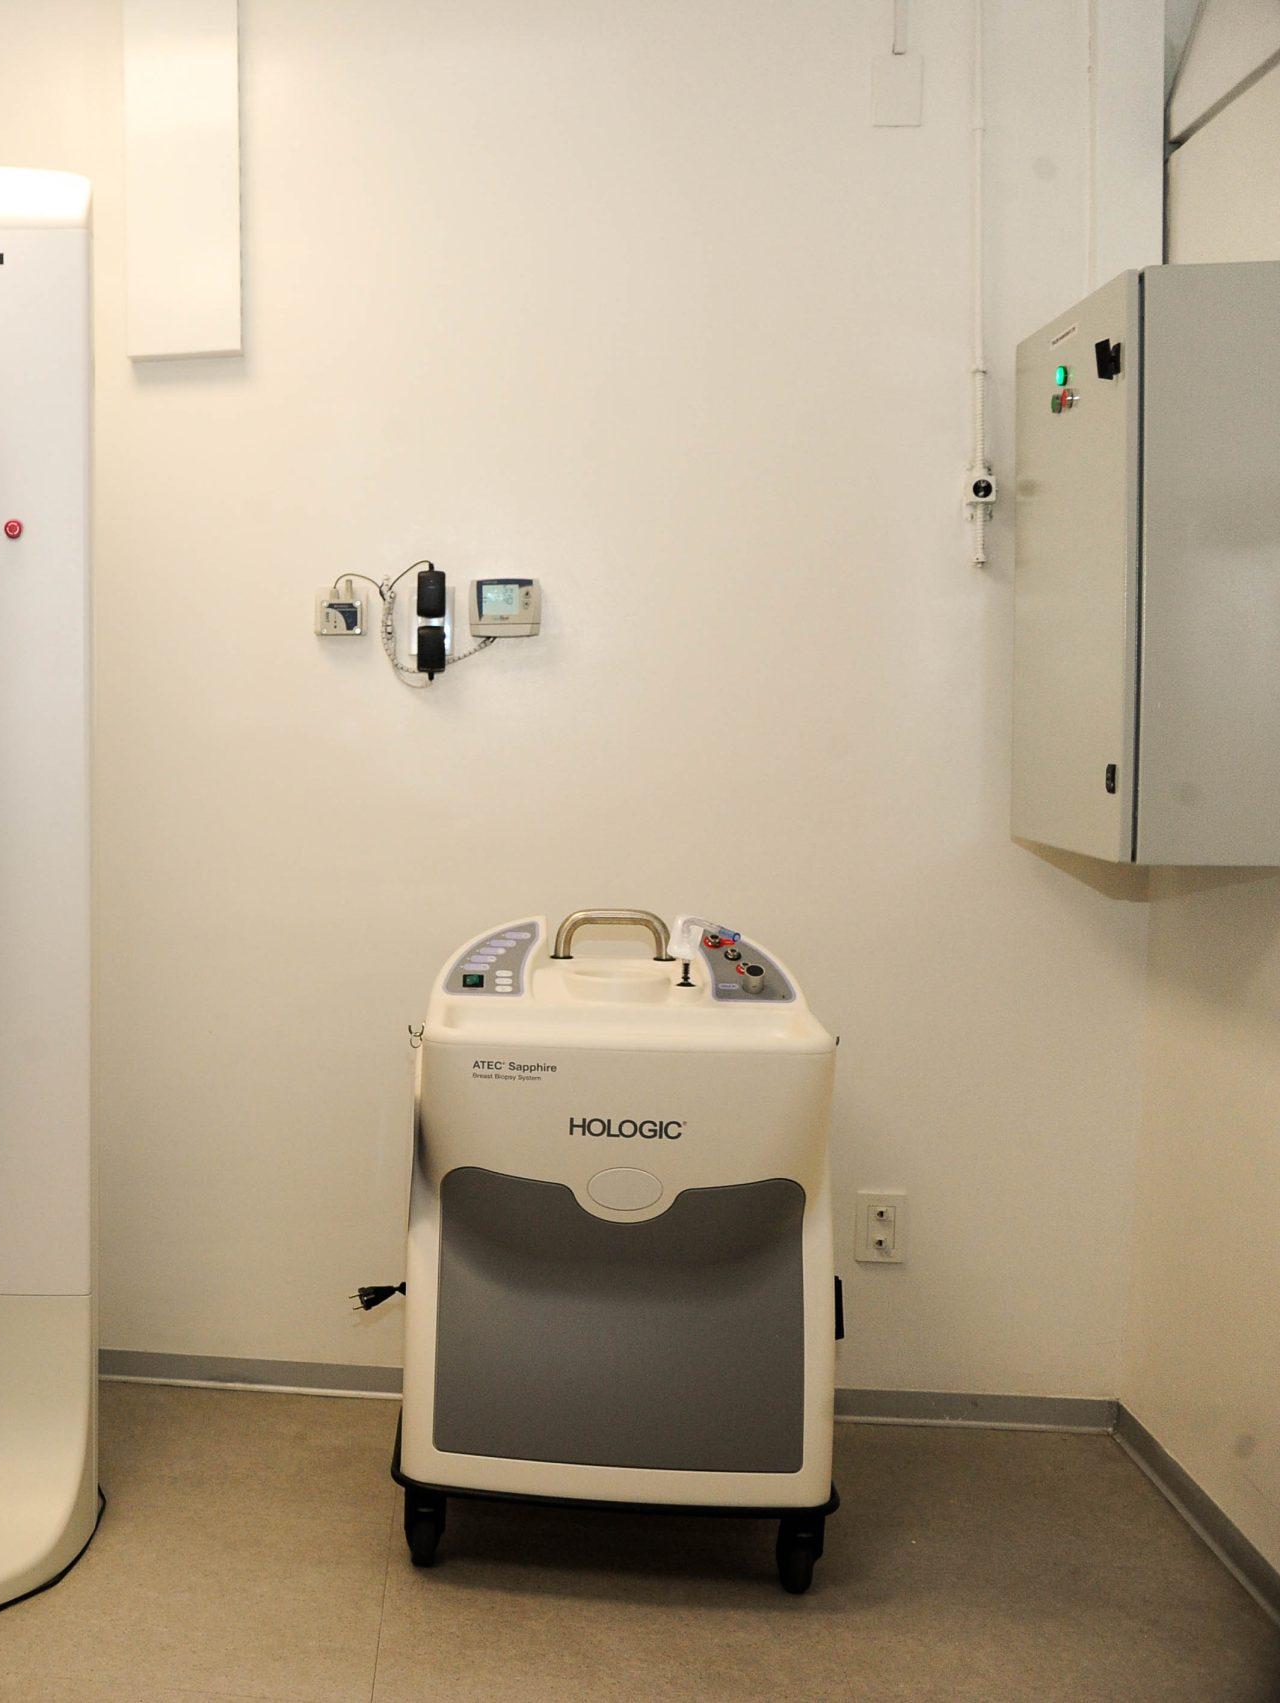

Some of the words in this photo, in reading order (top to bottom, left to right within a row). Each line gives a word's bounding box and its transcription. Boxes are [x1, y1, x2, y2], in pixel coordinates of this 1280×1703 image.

[508, 1061, 558, 1073] Sapphire
[494, 1073, 517, 1081] Biopsy
[568, 1116, 682, 1140] HOLOGIC
